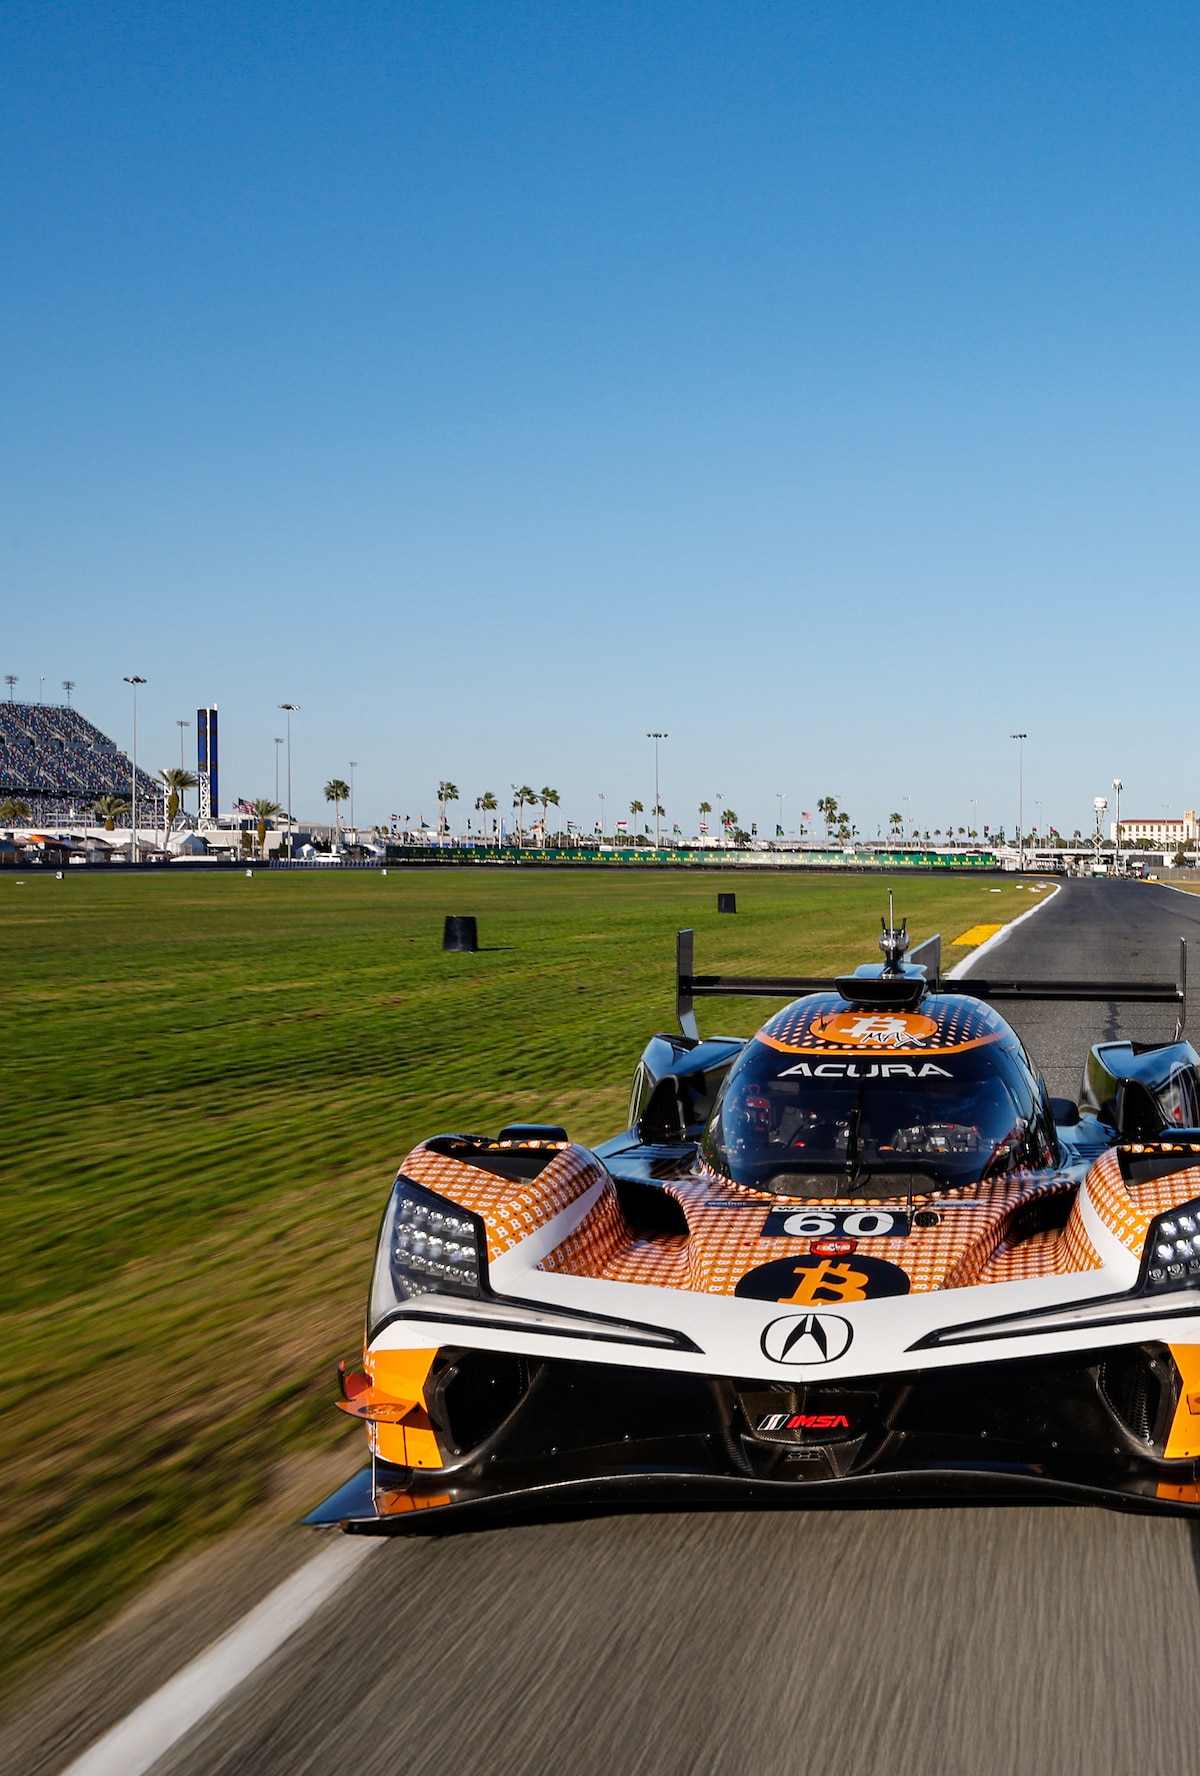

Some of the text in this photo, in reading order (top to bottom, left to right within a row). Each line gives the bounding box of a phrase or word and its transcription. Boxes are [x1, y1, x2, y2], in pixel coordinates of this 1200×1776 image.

[860, 1031, 926, 1048] MAX
[776, 1062, 954, 1078] ACURA
[783, 1212, 895, 1236] 60
[786, 1414, 850, 1428] IMSA
